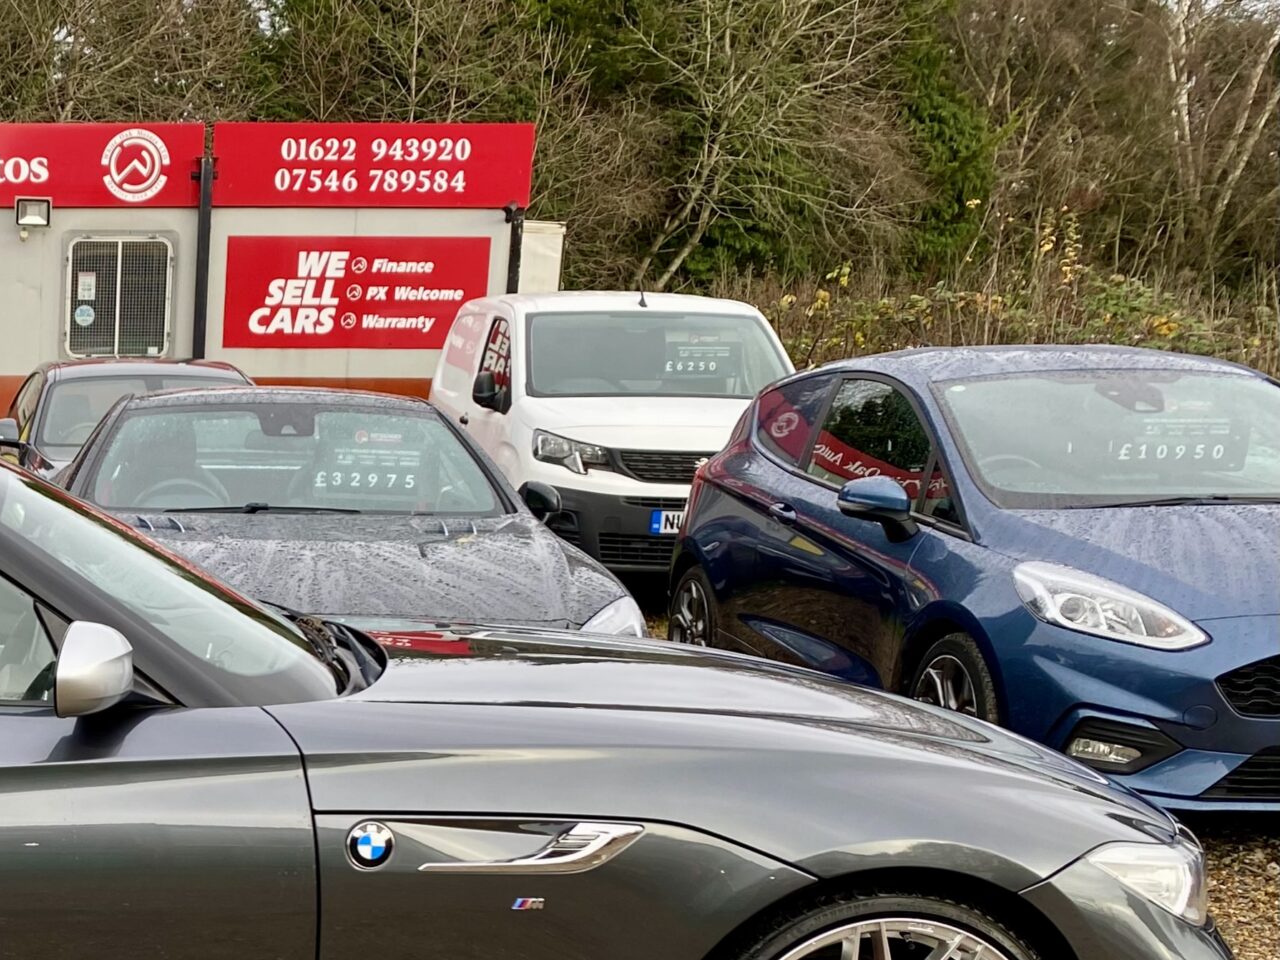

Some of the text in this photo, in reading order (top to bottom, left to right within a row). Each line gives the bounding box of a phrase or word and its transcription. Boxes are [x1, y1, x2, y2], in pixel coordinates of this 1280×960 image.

[281, 138, 471, 162] 01622 943920
[274, 169, 466, 192] 07546 789584
[297, 251, 350, 278] WE
[371, 259, 434, 274] Finance
[264, 279, 339, 305] SELL
[366, 286, 464, 301] PX Welcome
[248, 307, 336, 334] CARS
[361, 315, 436, 332] Warranty
[665, 360, 716, 372] £6250
[1118, 443, 1224, 460] £10950
[314, 471, 415, 488] £32975
